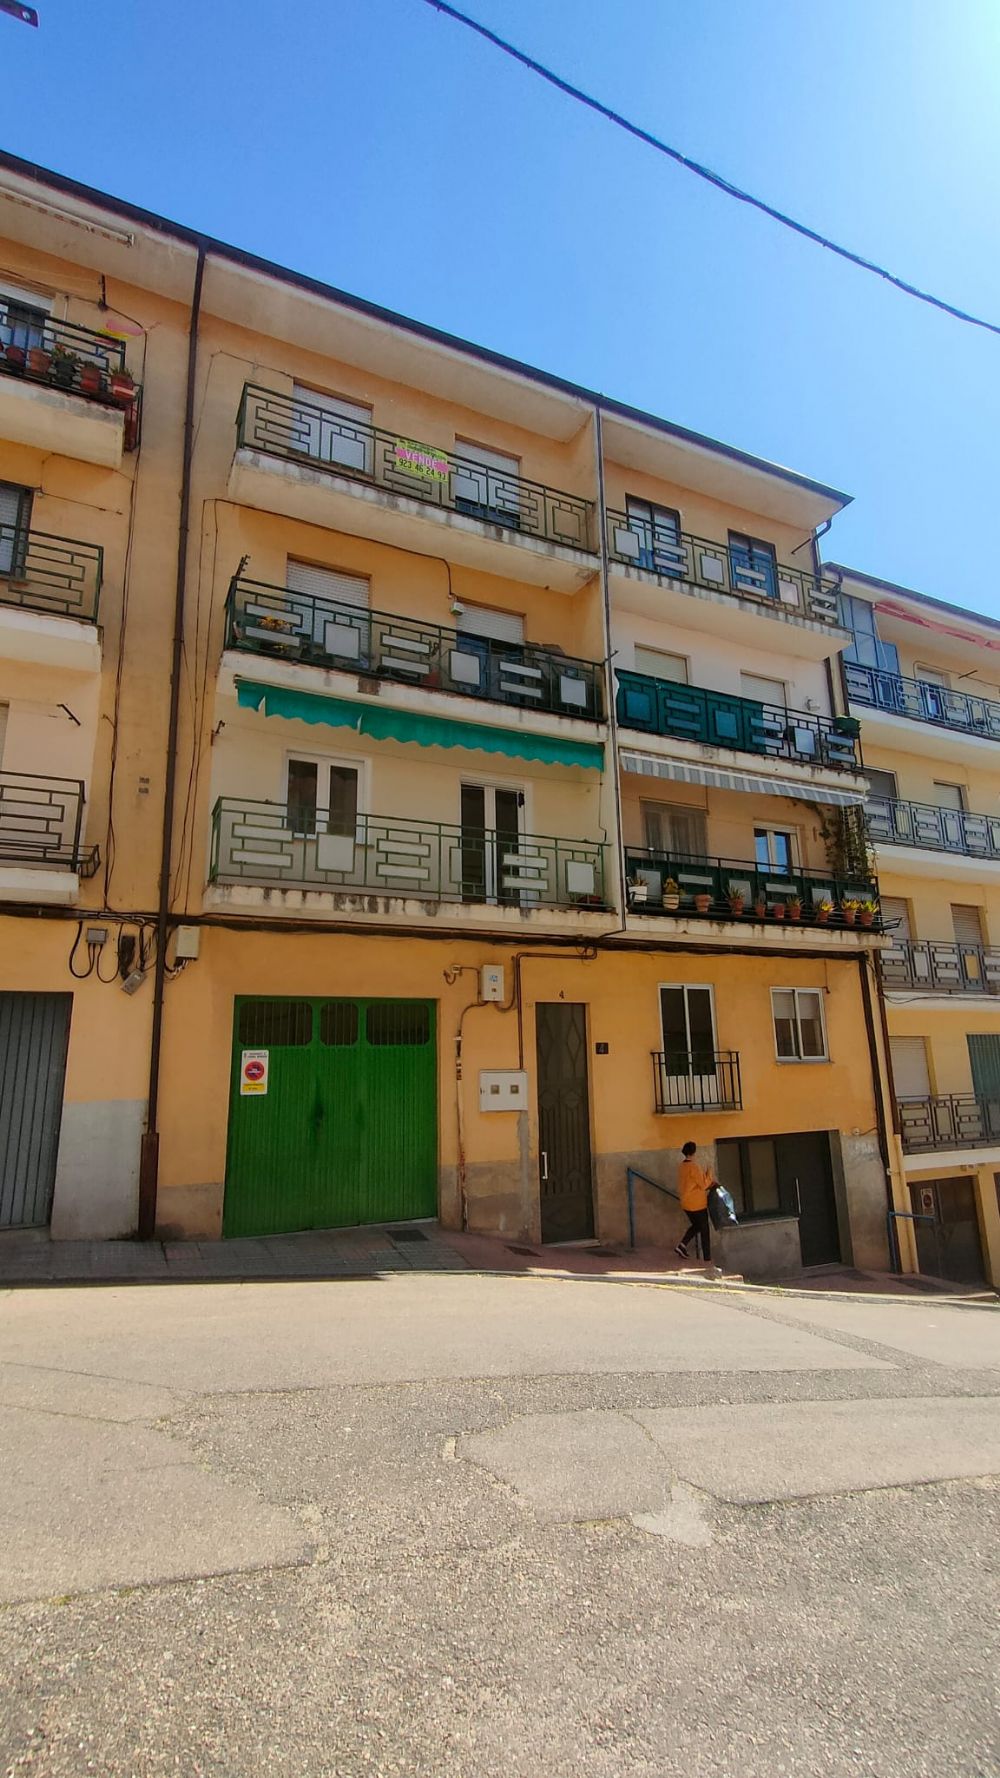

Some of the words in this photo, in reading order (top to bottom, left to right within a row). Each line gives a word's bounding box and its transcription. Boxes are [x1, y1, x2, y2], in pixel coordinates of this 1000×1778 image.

[399, 458, 412, 468] 923
[426, 466, 435, 476] 24
[405, 450, 438, 468] VENDE
